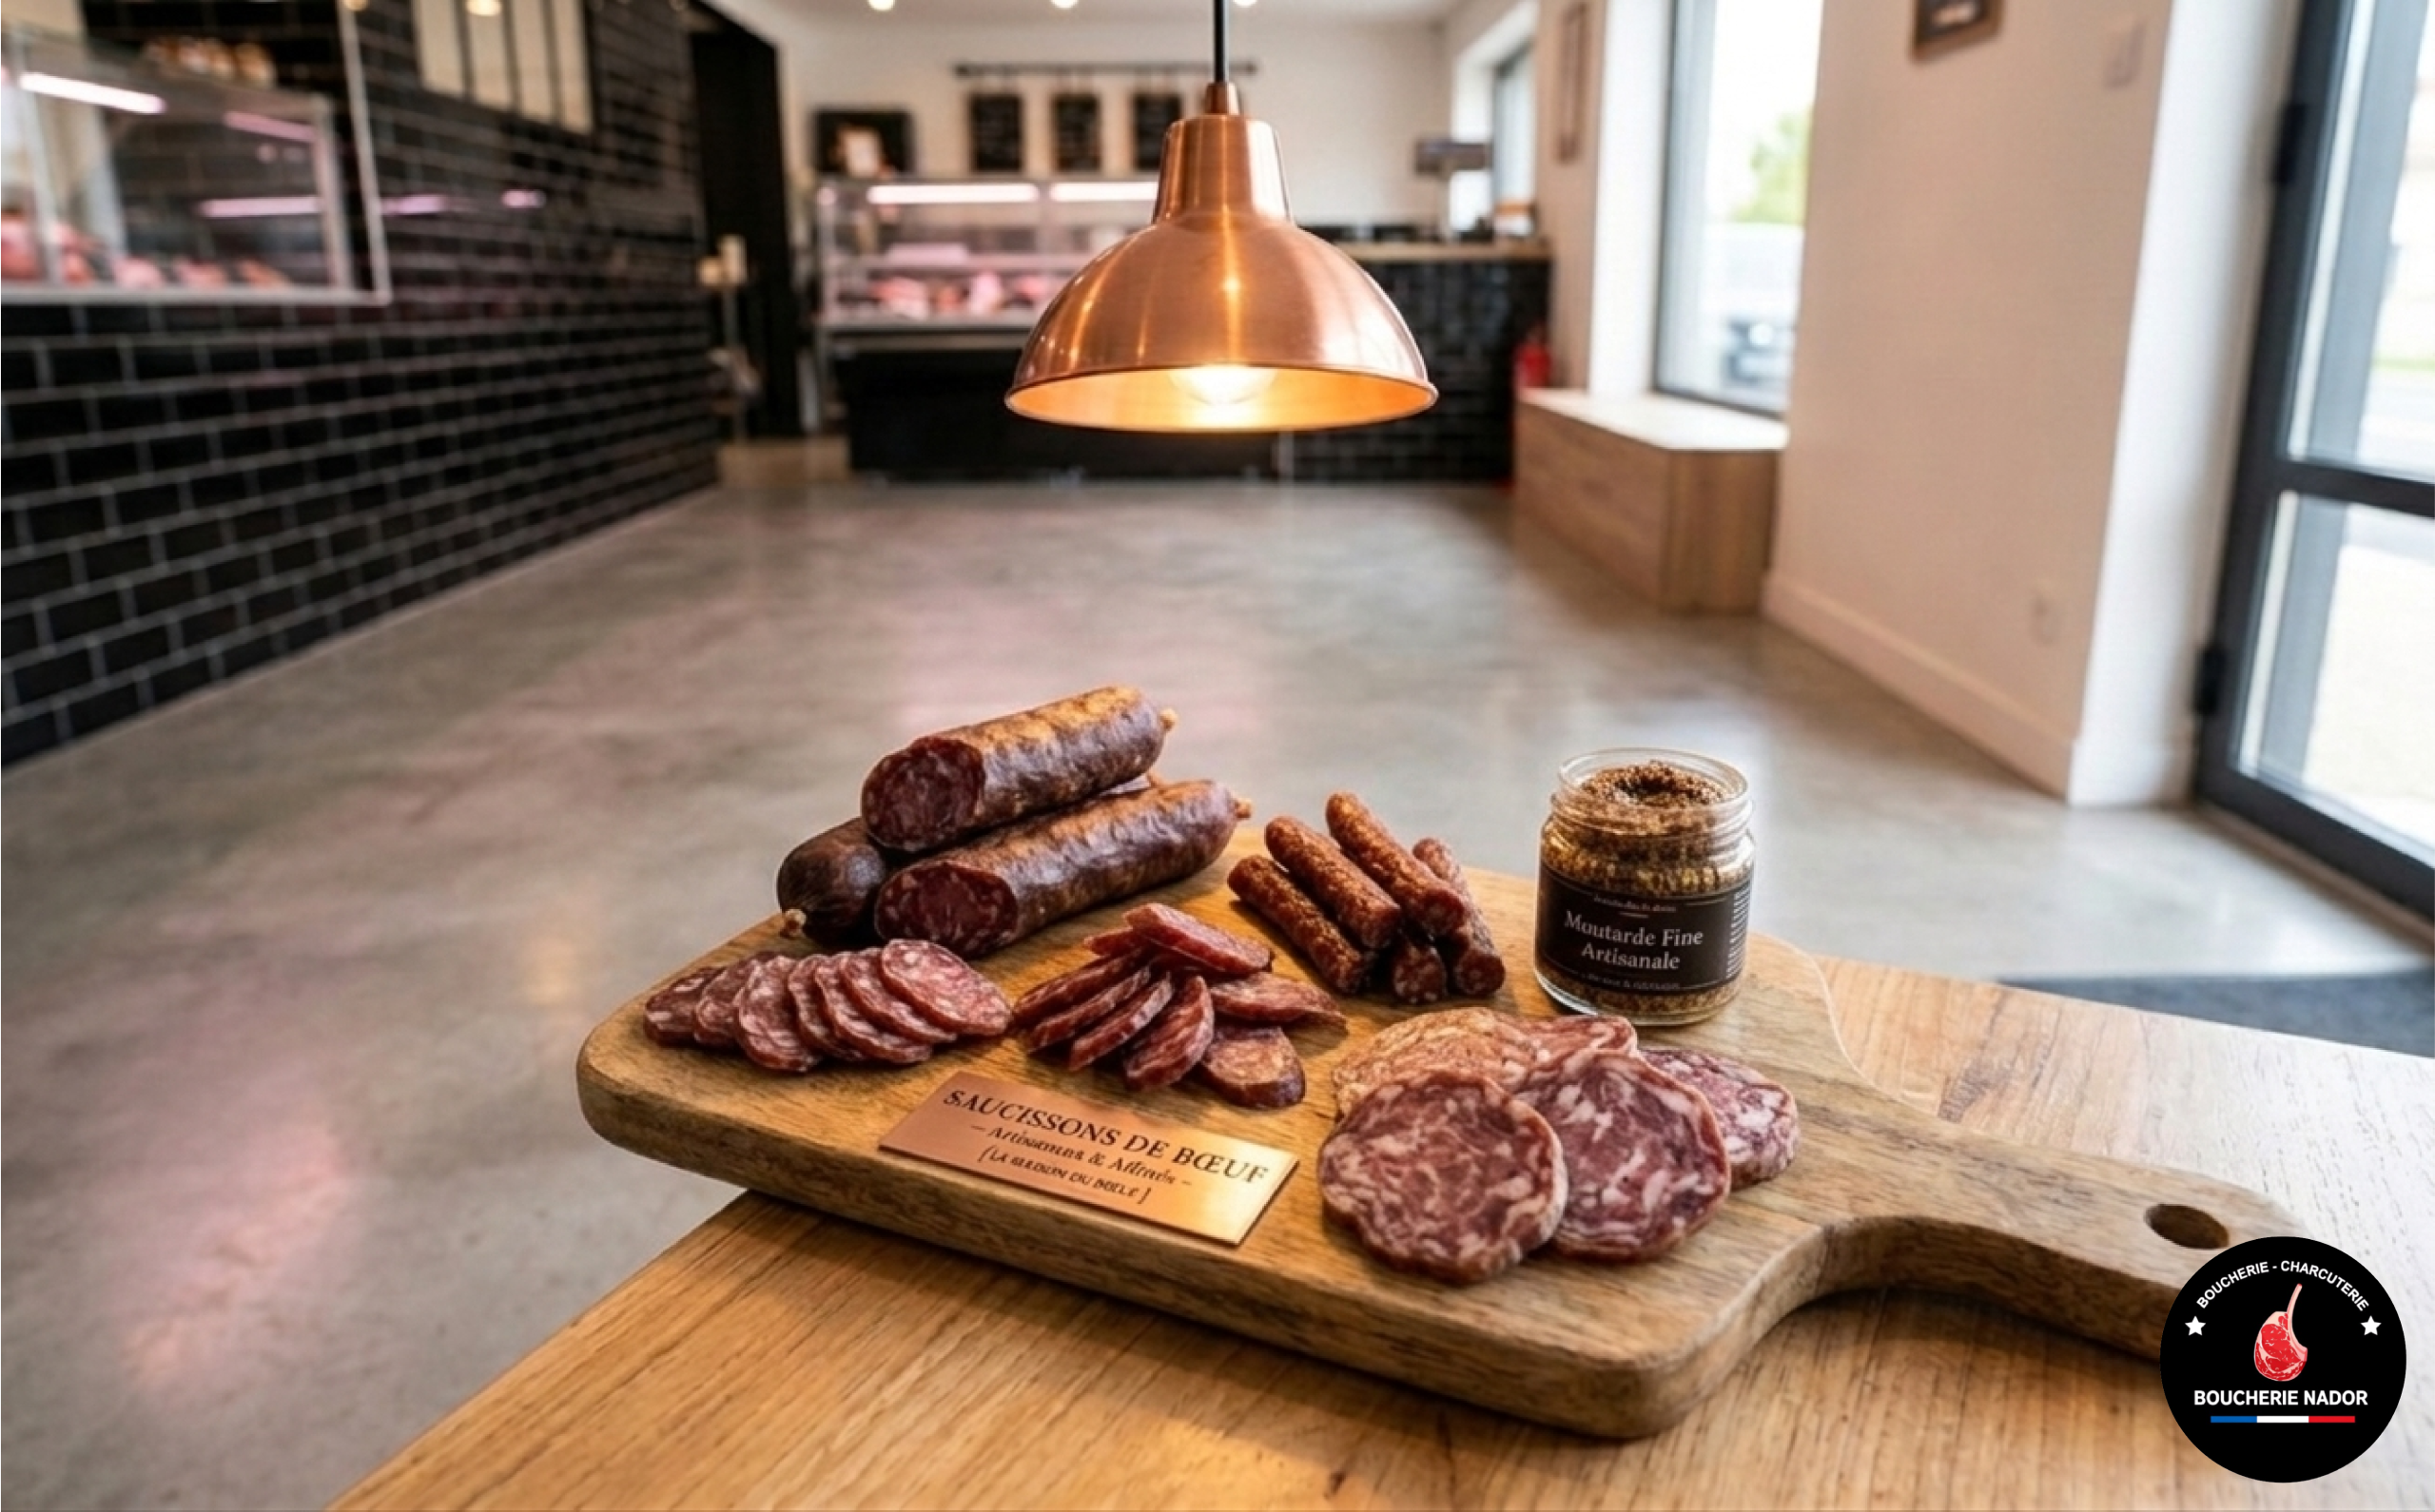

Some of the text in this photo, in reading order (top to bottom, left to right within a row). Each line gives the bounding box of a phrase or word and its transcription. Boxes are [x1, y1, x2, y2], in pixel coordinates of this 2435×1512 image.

[1662, 929, 1704, 947] Fine
[1581, 943, 1681, 970] Artisanale
[943, 1090, 1270, 1185] SAUCISSONS DE BŒUF
